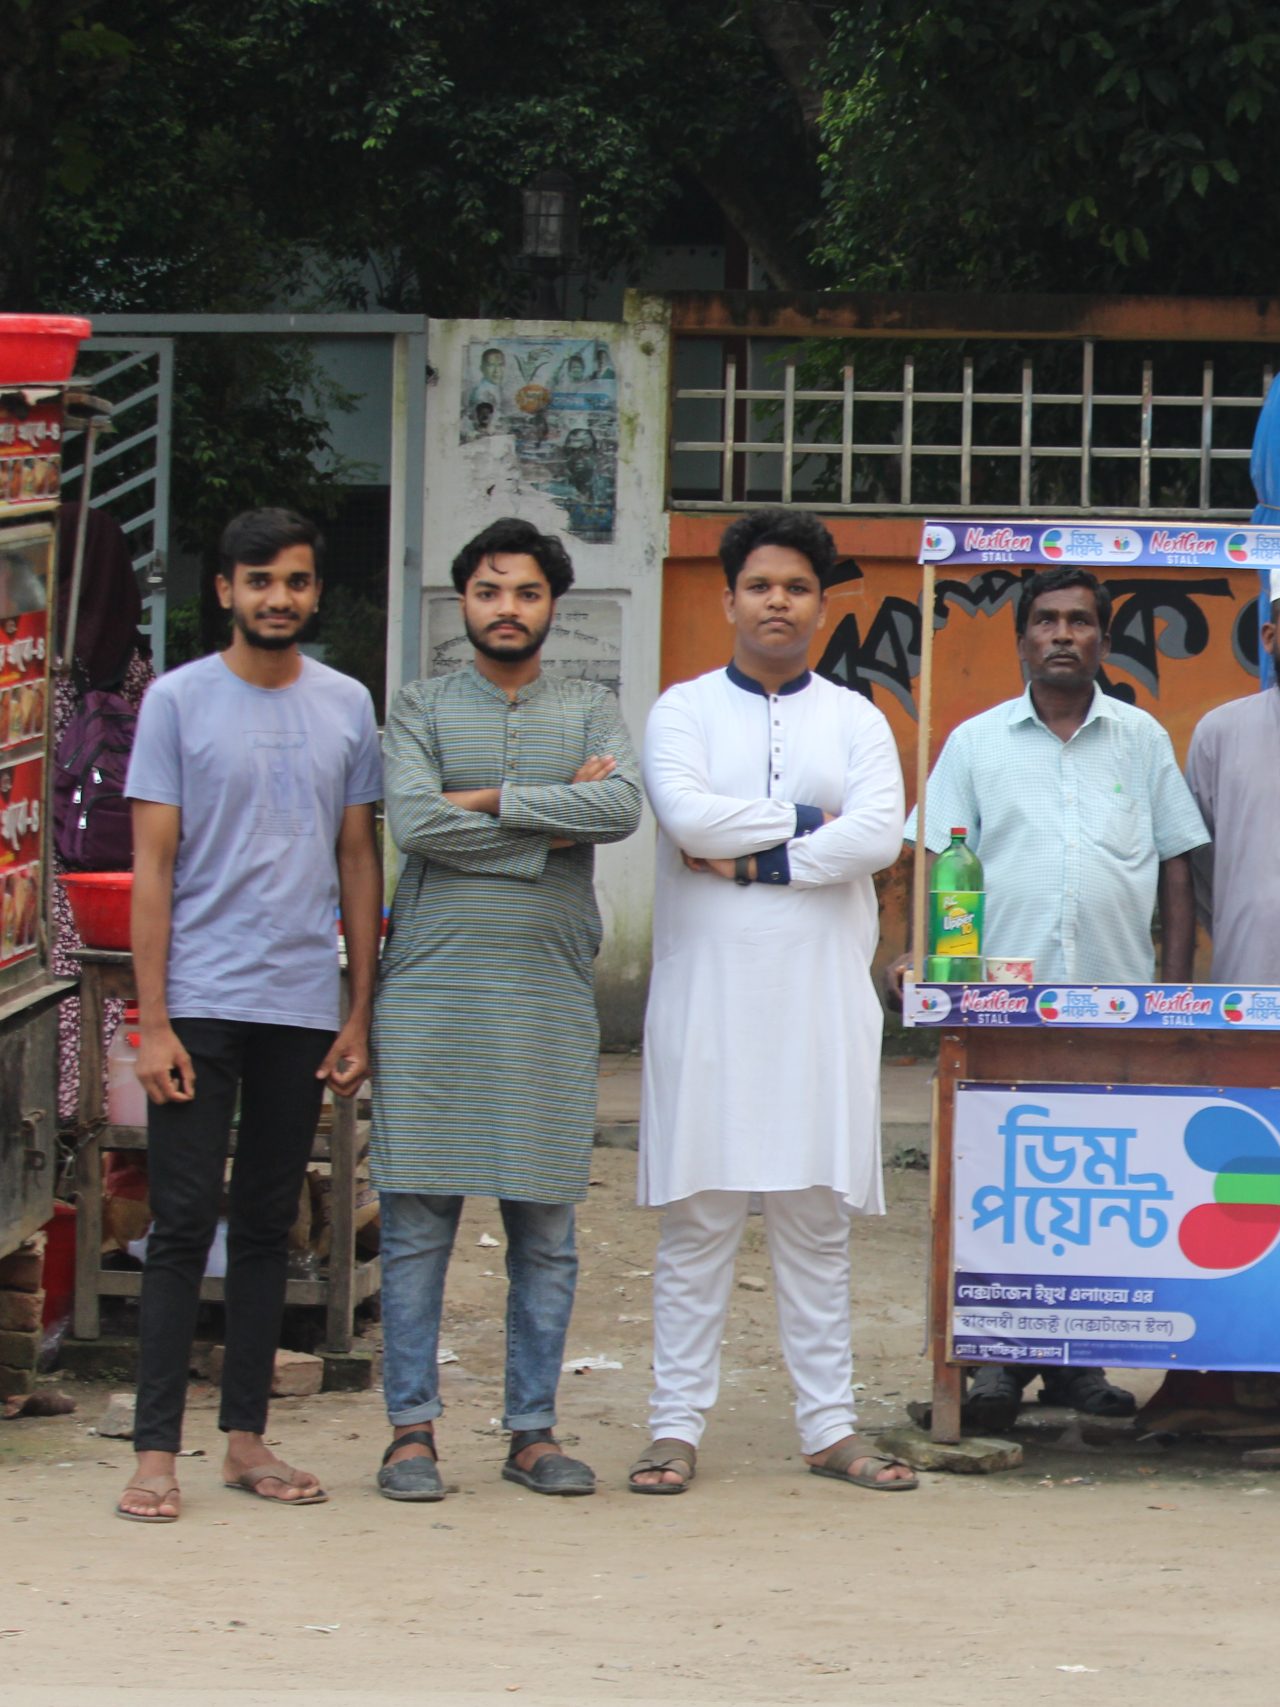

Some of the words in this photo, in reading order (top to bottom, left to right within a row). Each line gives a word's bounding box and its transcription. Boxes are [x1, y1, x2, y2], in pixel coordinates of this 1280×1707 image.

[965, 528, 1032, 551] NextGen
[1150, 531, 1216, 555] NextGen
[981, 552, 1014, 561] STALL
[1167, 555, 1199, 564] STALL
[961, 989, 1029, 1013] NextGen
[1145, 991, 1212, 1014] NextGen
[978, 1014, 1011, 1024] STALL
[1162, 1016, 1194, 1025] STALL
[998, 1104, 1137, 1186] ডিম
[971, 1172, 1174, 1256] পয়েন্ট
[958, 1283, 1032, 1300] নেক্সটজেন
[1132, 1290, 1154, 1304] এর
[960, 1311, 1013, 1329] স্বাবলম্বী
